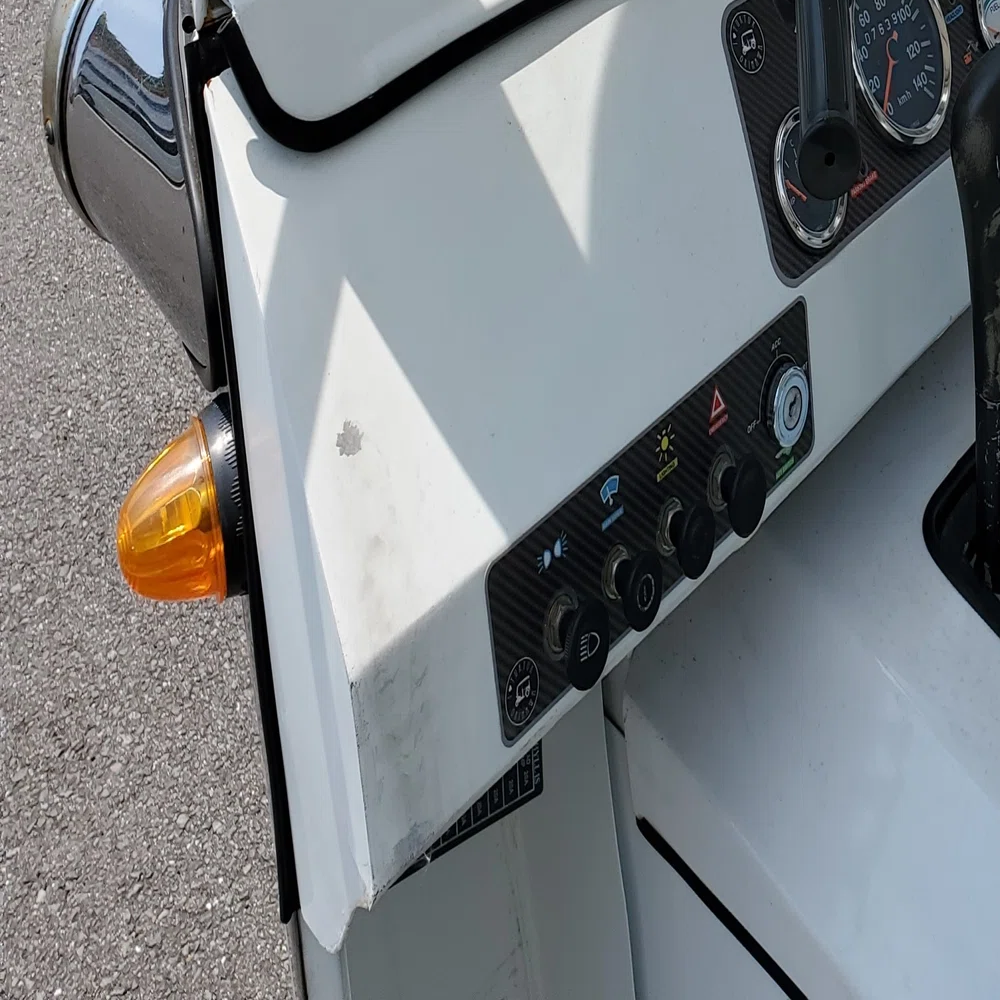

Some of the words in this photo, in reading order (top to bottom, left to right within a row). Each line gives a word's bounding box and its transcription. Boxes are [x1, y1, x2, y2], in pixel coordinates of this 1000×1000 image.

[897, 4, 912, 24] 100
[989, 2, 1000, 14] FUEL
[858, 9, 871, 28] 60
[906, 40, 921, 60] 120
[868, 75, 881, 93] 20
[912, 71, 928, 92] 140
[886, 102, 894, 116] 0
[770, 337, 782, 353] ACC
[746, 419, 758, 434] OFF
